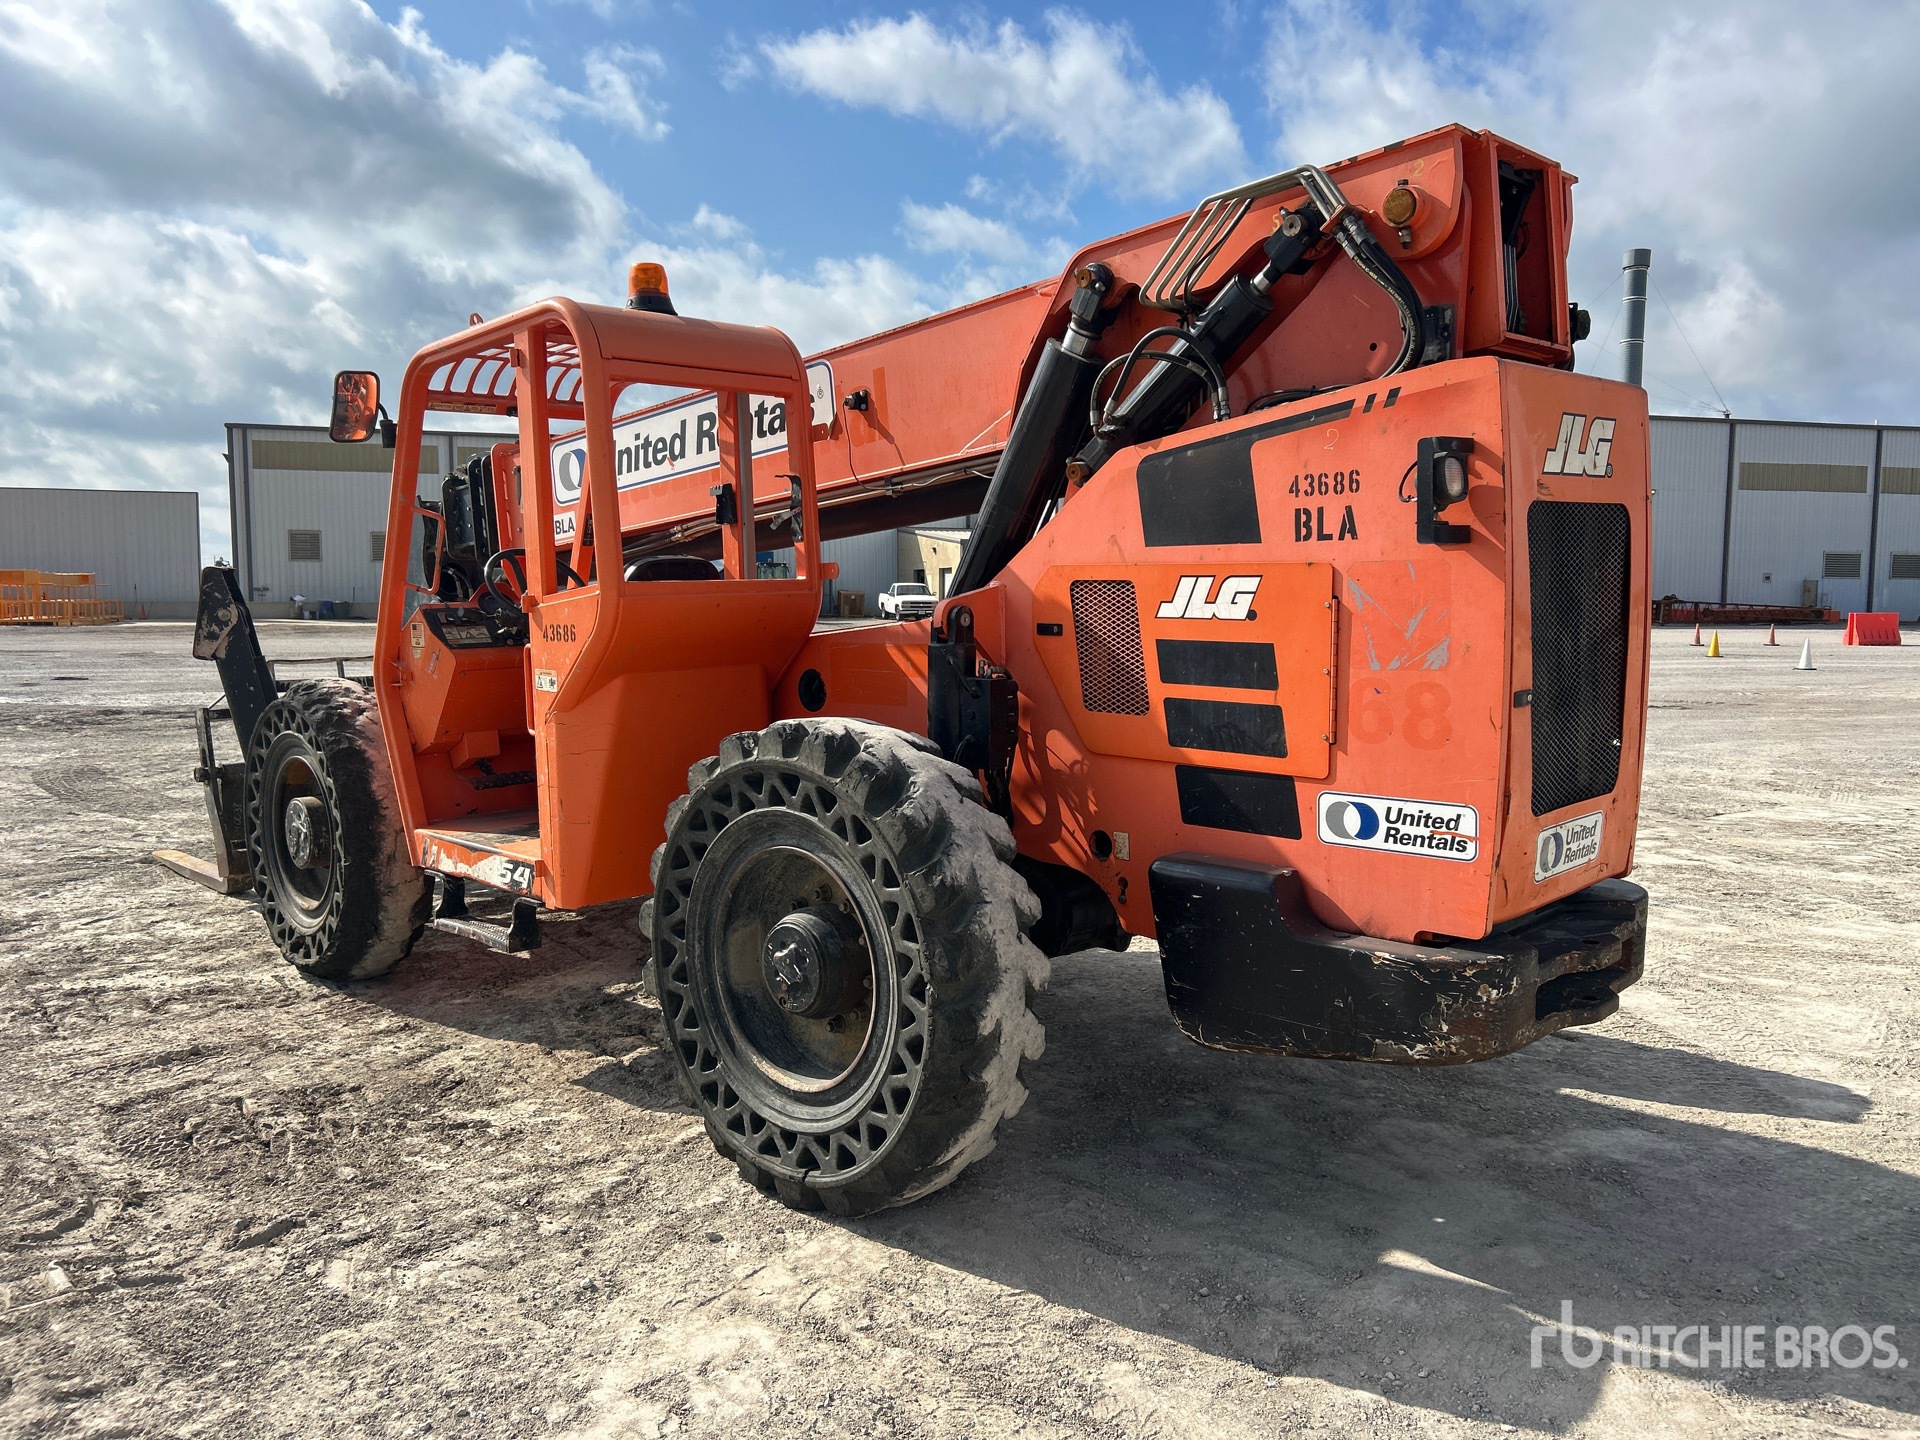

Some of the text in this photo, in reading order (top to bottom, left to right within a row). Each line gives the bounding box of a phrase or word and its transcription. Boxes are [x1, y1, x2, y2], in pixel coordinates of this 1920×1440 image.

[613, 419, 688, 477] nited
[1323, 428, 1339, 450] 2
[1542, 412, 1616, 478] JLG
[1288, 469, 1360, 498] 43686
[555, 519, 575, 536] BLA
[1295, 505, 1358, 542] BLA
[1155, 575, 1263, 621] JLG
[543, 624, 576, 643] 43686
[1384, 806, 1462, 831] United
[1384, 827, 1468, 852] Rentals
[1566, 820, 1598, 846] United
[1563, 839, 1598, 865] Rentals
